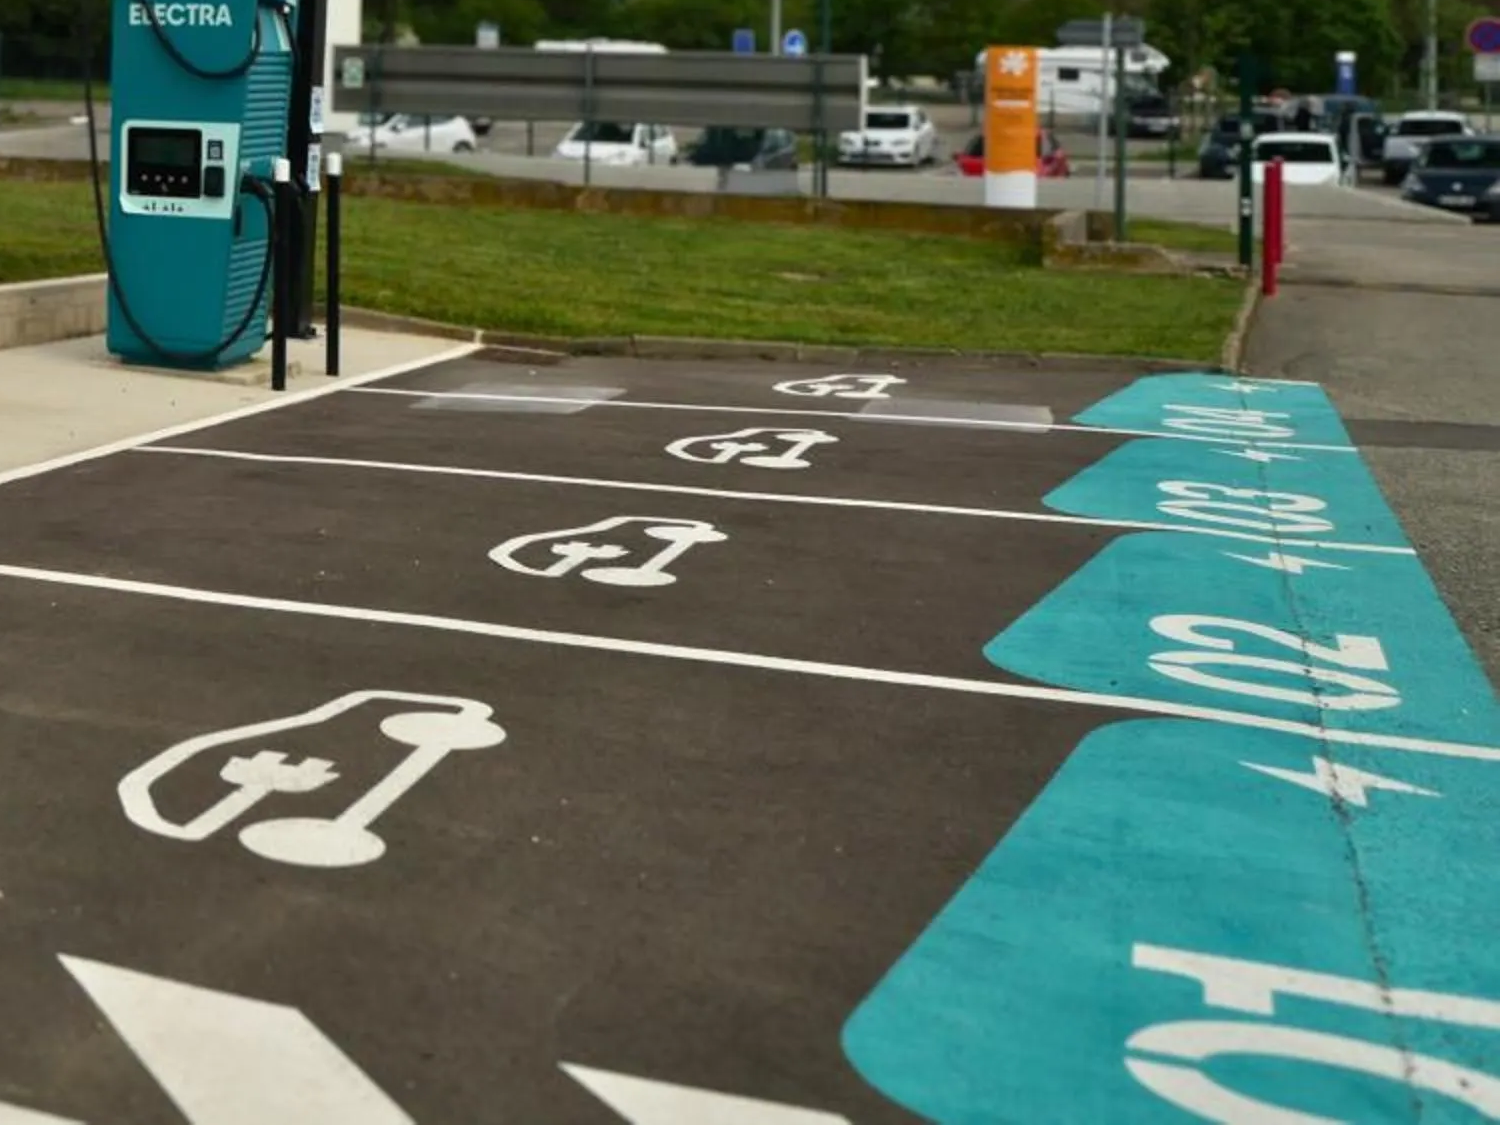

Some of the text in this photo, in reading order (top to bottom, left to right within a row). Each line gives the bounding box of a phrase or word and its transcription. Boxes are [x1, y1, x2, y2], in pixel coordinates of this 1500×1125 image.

[1156, 480, 1334, 532] 03
[1148, 615, 1402, 711] 02
[1124, 942, 1500, 1125] 01
